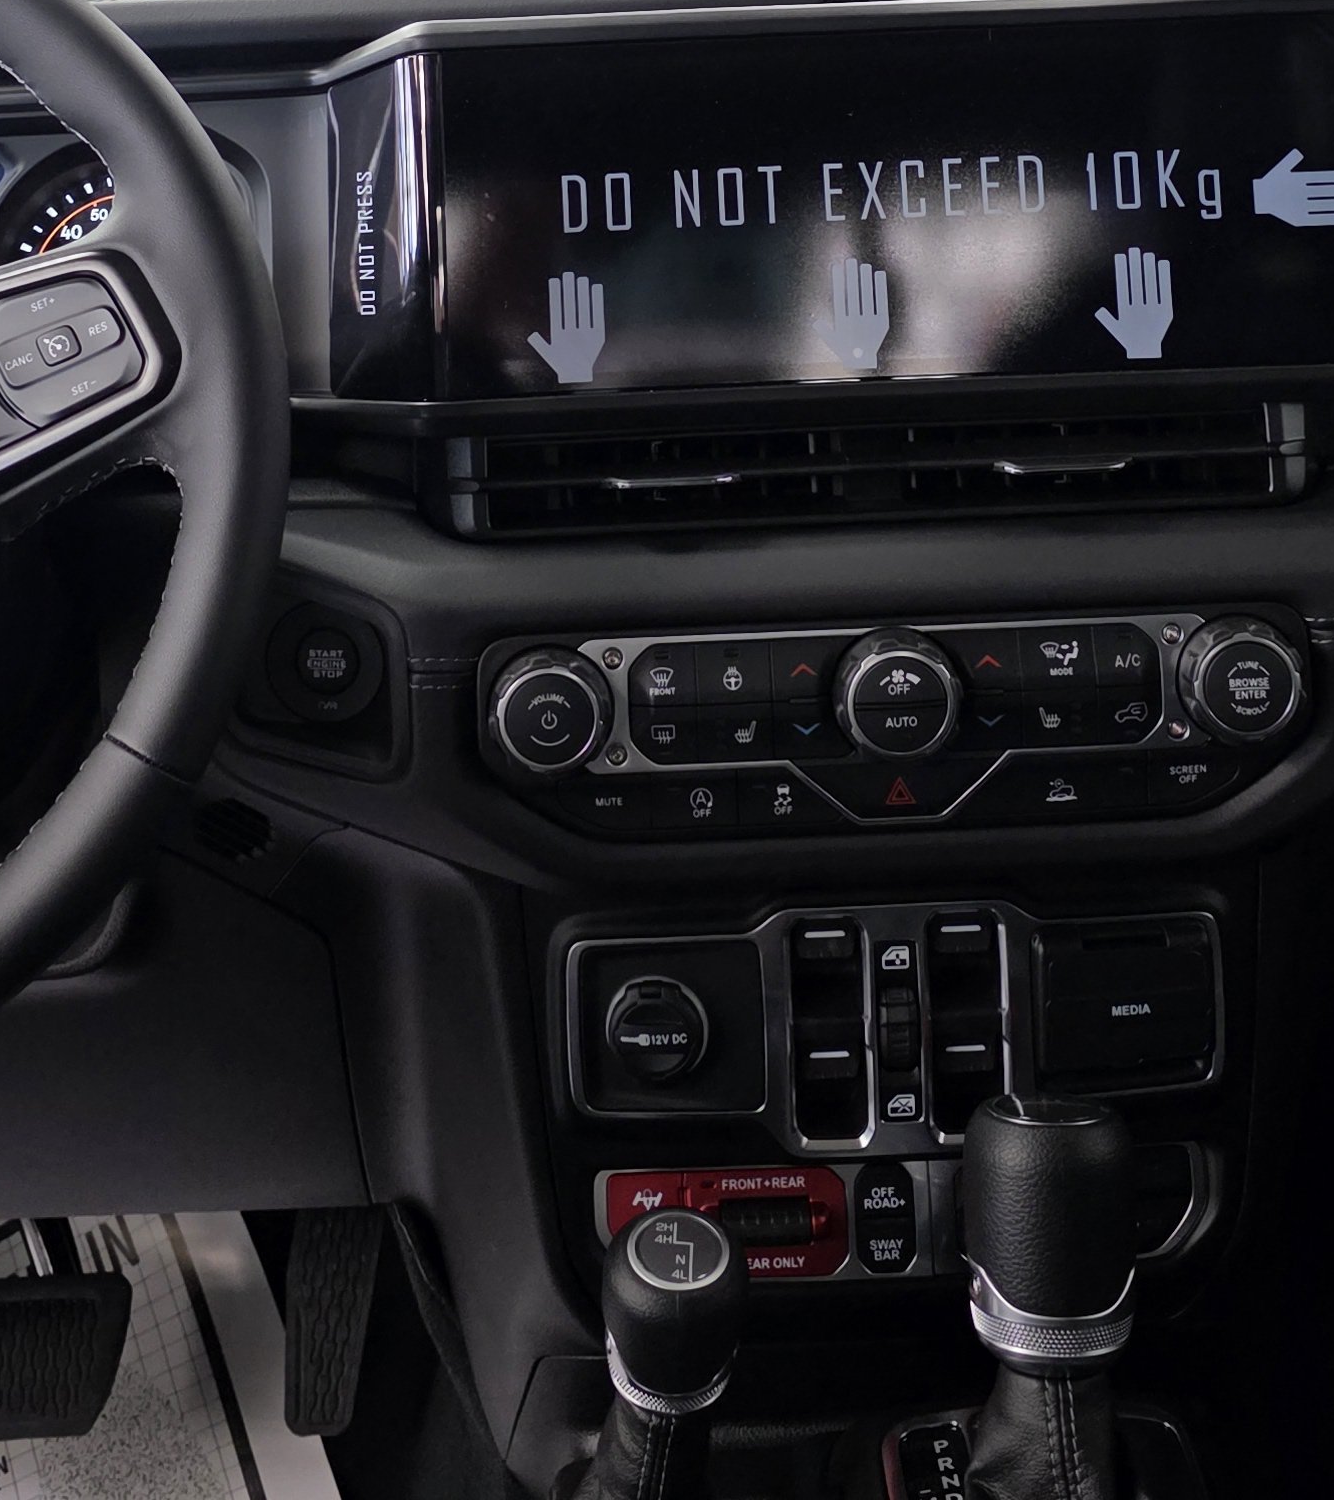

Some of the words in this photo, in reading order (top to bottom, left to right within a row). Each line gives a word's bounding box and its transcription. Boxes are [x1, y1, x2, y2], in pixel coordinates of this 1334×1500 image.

[562, 172, 633, 233] DO
[673, 164, 783, 229] NOT
[821, 153, 1047, 224] EXCEED
[1084, 146, 1224, 219] 10Kg
[356, 171, 374, 234] PRESS
[90, 208, 108, 222] 50
[60, 224, 83, 241] 40
[358, 243, 375, 280] NOT
[360, 290, 376, 316] DO
[88, 321, 109, 337] RES
[4, 353, 34, 372] CANC
[308, 648, 344, 658] START
[306, 659, 347, 670] ENGINE
[1115, 653, 1141, 668] A/C
[1237, 661, 1260, 671] TUNE
[313, 670, 344, 679] STOP
[1049, 668, 1074, 676] MODE
[1228, 677, 1270, 688] BROWSE
[649, 687, 676, 696] FRONT
[888, 684, 911, 696] OFF
[1234, 690, 1267, 700] ENTER
[532, 695, 565, 706] VOLUME
[1235, 705, 1267, 716] SCROLL
[885, 716, 918, 729] AUTO
[1169, 764, 1207, 775] SCREEN
[1179, 774, 1197, 785] OFF
[595, 797, 624, 807] MUTE
[693, 808, 712, 818] OFF
[774, 806, 793, 816] OFF
[1111, 1003, 1151, 1017] MEDIA
[650, 1033, 670, 1045] 12V
[671, 1032, 688, 1045] DC
[871, 1187, 895, 1199] OFF
[656, 1222, 673, 1232] 2H
[654, 1234, 674, 1244] 4H
[869, 1239, 904, 1251] SWAY
[675, 1254, 685, 1265] N
[873, 1249, 900, 1261] BAR
[773, 1256, 806, 1269] ONLY
[671, 1270, 687, 1279] 4L
[933, 1439, 949, 1454] P
[937, 1457, 955, 1471] R
[941, 1473, 961, 1489] N
